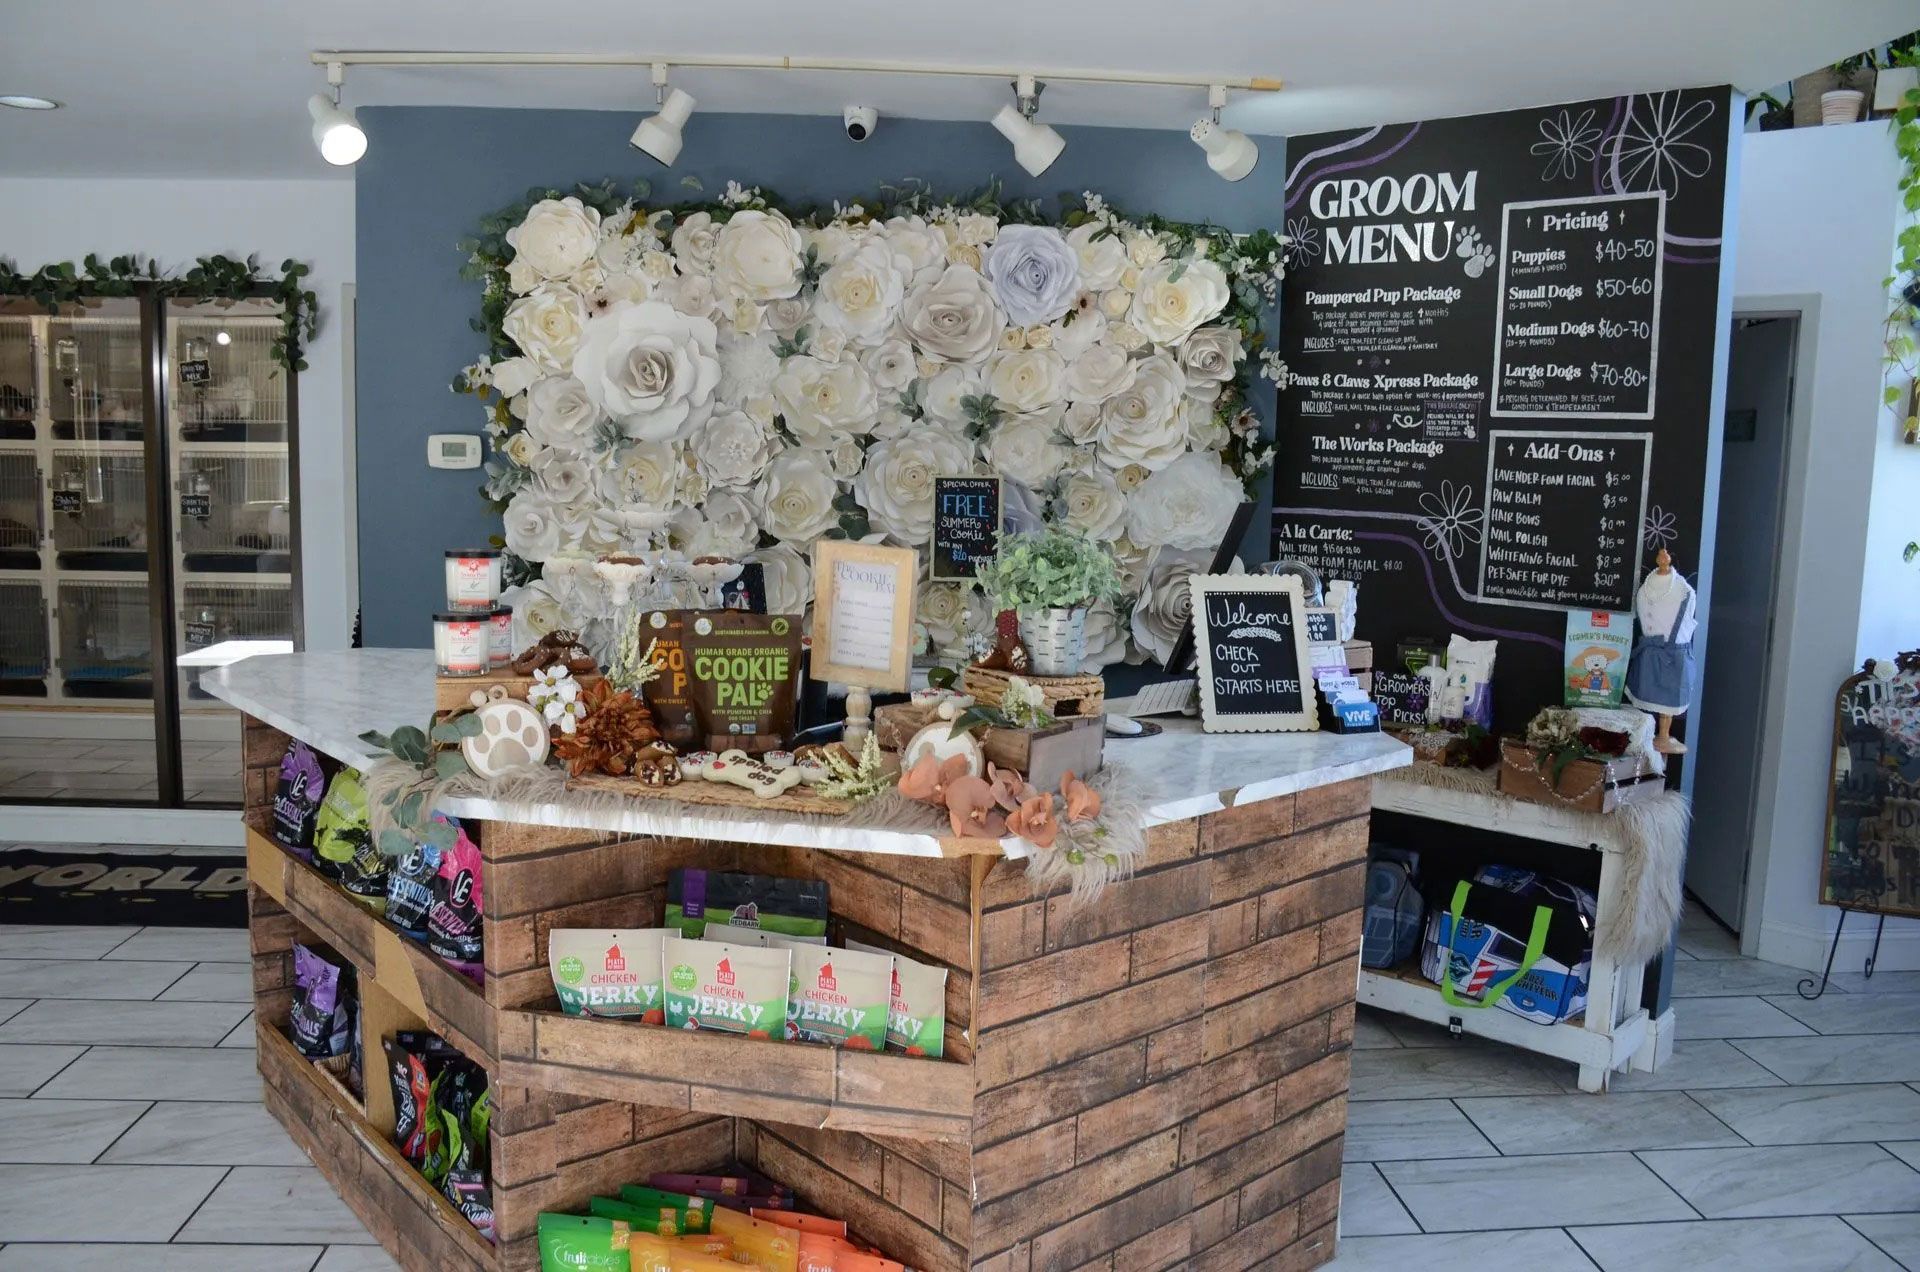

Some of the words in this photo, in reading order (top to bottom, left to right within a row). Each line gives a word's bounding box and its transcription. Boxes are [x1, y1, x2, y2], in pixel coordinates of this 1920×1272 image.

[1310, 171, 1477, 219] GROOM
[1543, 211, 1609, 232] Pricing
[1324, 221, 1455, 265] MENU
[1595, 239, 1655, 263] $40-50
[1511, 248, 1566, 265] Puppies
[1305, 289, 1371, 307] Pampered
[1373, 288, 1400, 305] Pup
[1403, 286, 1461, 303] Package
[1509, 285, 1545, 300] Small
[1548, 284, 1583, 301] Dogs
[1596, 277, 1652, 298] $50-60
[1507, 323, 1558, 337] Medium
[1560, 321, 1595, 338] Dogs
[1597, 317, 1650, 339] $60-70
[1505, 363, 1544, 380] Large
[1546, 363, 1581, 381] Dogs
[1590, 361, 1648, 387] $70-80+
[1287, 373, 1320, 386] Paws
[1321, 374, 1332, 387] &
[1334, 374, 1370, 388] Claws
[1373, 375, 1421, 391] Xpress
[1423, 373, 1478, 390] Package
[1312, 436, 1337, 450] The
[1339, 436, 1384, 452] Works
[1386, 438, 1444, 457] Package
[942, 480, 969, 488] SPECIAL
[969, 480, 992, 488] OFFER
[1494, 468, 1540, 485] LAVENDER
[1540, 474, 1563, 486] FOAM
[1566, 474, 1596, 487] FACIAL
[943, 494, 990, 517] FREE
[1492, 488, 1513, 503] PAW
[1515, 493, 1541, 505] BALM
[941, 516, 982, 529] SUMMER
[1491, 508, 1513, 522] HAIR
[1515, 512, 1540, 526] BOWS
[1280, 523, 1291, 538] A
[1294, 524, 1307, 538] la
[1308, 525, 1353, 541] Carte:
[1490, 527, 1512, 543] NAIL
[1515, 531, 1548, 546] POLISH
[1279, 540, 1294, 553] NAIL
[1298, 543, 1318, 555] TRIM
[1488, 545, 1543, 565] WHITENING
[1546, 552, 1578, 567] FACIAL
[1321, 556, 1345, 568] FOAM
[1347, 559, 1380, 571] FACIAL
[1531, 571, 1549, 585] FUR
[1551, 574, 1570, 586] DYE
[1206, 598, 1292, 629] Welcome
[654, 640, 680, 648] UMAN
[695, 648, 724, 656] HUMAN
[726, 648, 752, 656] GRADE
[754, 647, 789, 656] ORGANIC
[1215, 643, 1260, 662] CHECK
[695, 657, 789, 681] COOKIE
[1230, 663, 1261, 674] OUT
[717, 682, 763, 706] PAL
[1215, 677, 1263, 696] STARTS
[1266, 679, 1300, 694] HERE
[1393, 708, 1425, 725] PICKS!
[729, 754, 786, 775] spoiled
[747, 769, 777, 786] dog
[591, 974, 637, 984] CHICKEN
[577, 984, 658, 1006] JERKY
[703, 984, 745, 1000] CHICKEN
[805, 988, 848, 1005] CHICKEN
[687, 994, 764, 1025] JERKY
[787, 998, 866, 1031] JERKY
